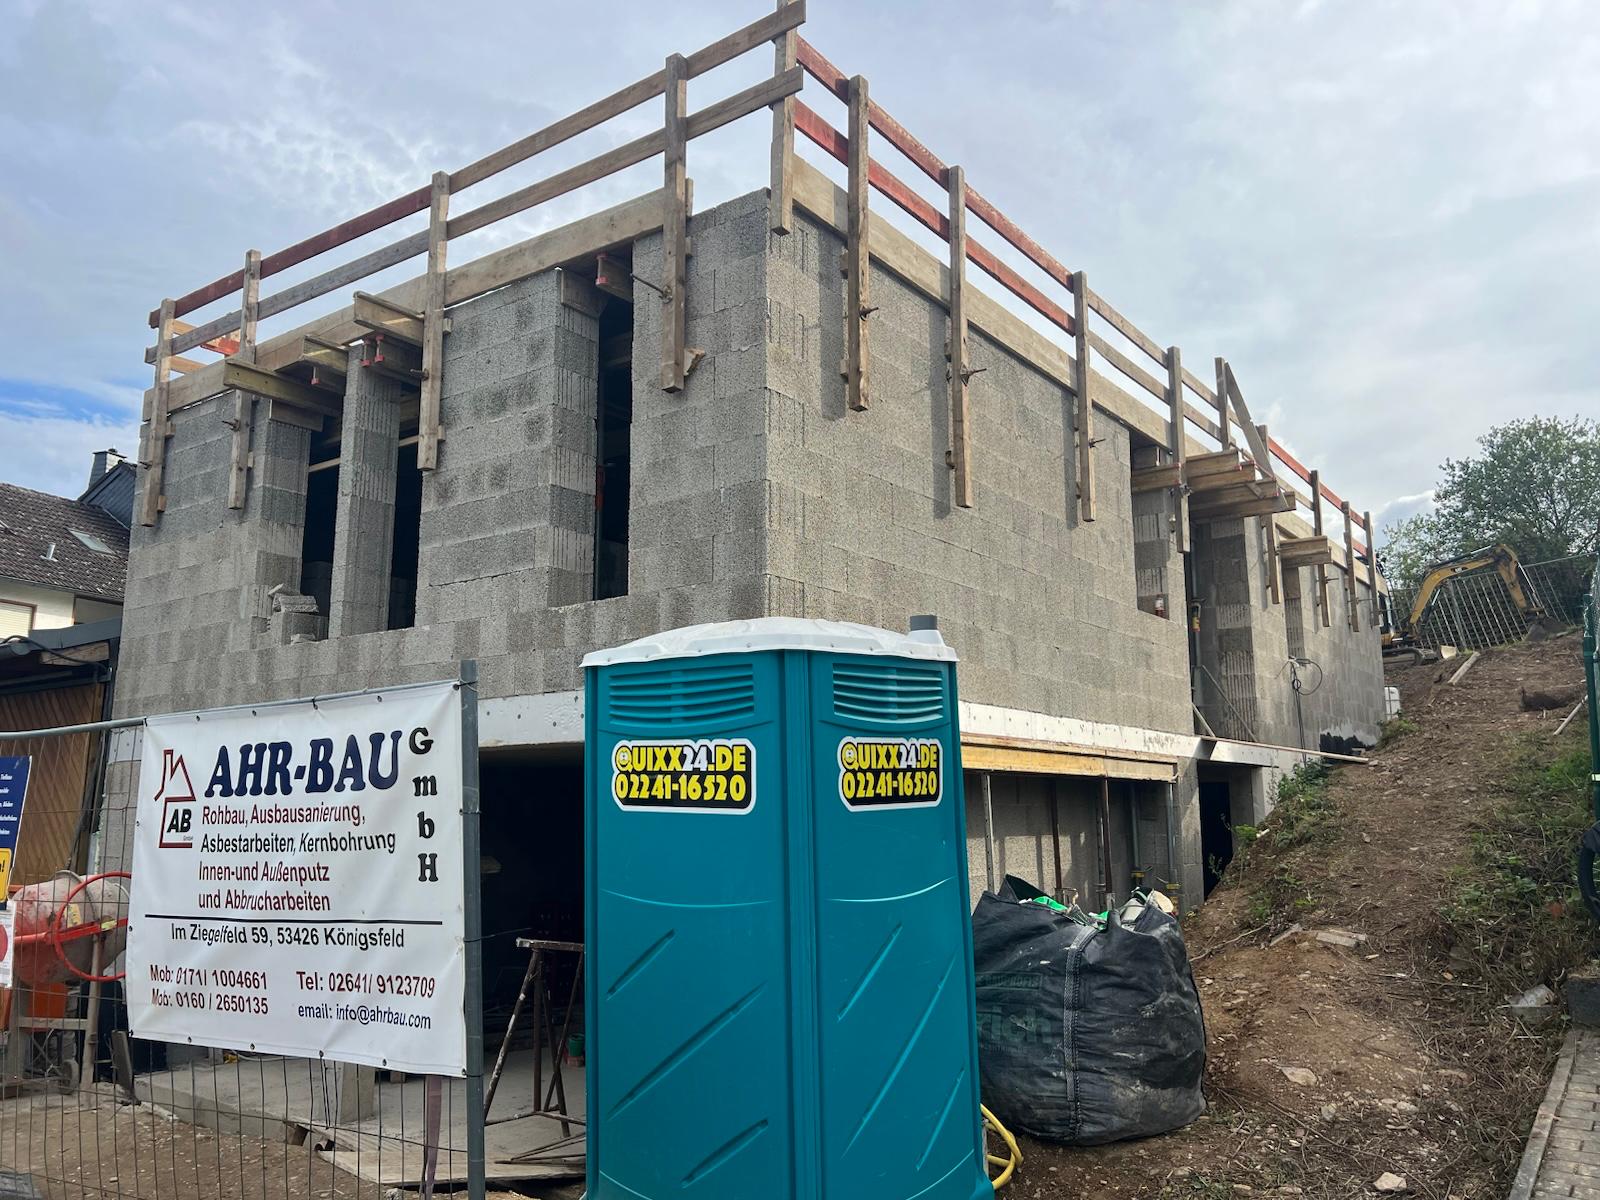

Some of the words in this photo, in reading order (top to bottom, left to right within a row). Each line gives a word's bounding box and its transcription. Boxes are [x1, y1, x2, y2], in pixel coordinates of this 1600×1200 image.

[204, 730, 402, 798] AHR-BAU
[615, 745, 747, 774] QUIXX24.DE
[841, 742, 938, 772] QUIXX24.DE
[615, 773, 747, 802] 02241-16520
[842, 771, 938, 799] 02241-16520
[166, 808, 192, 833] AB
[202, 805, 249, 828] Rohbau,
[250, 802, 366, 827] Ausbausanierung,
[200, 832, 297, 856] Asbestarbeiten,
[299, 831, 396, 855] Kernbohrung
[199, 861, 259, 882] Innen-und
[261, 861, 331, 887] Außenputz
[198, 889, 221, 909] und
[225, 888, 331, 912] Abbrucharbeiten
[171, 922, 187, 940] Im
[190, 923, 248, 947] Ziegelfeld
[251, 926, 273, 948] 59,
[277, 926, 320, 946] 53426
[324, 927, 405, 951] Königsfeld
[150, 964, 174, 983] Mob:
[212, 968, 268, 990] 1004661
[296, 971, 324, 991] Tel:
[328, 972, 373, 994] 02641/
[376, 974, 435, 998] 9123709
[152, 987, 173, 1008] Mob:
[175, 991, 205, 1009] 0160
[216, 993, 269, 1015] 2650135
[298, 1002, 333, 1020] email:
[336, 1003, 432, 1030] info@ahrbau.com
